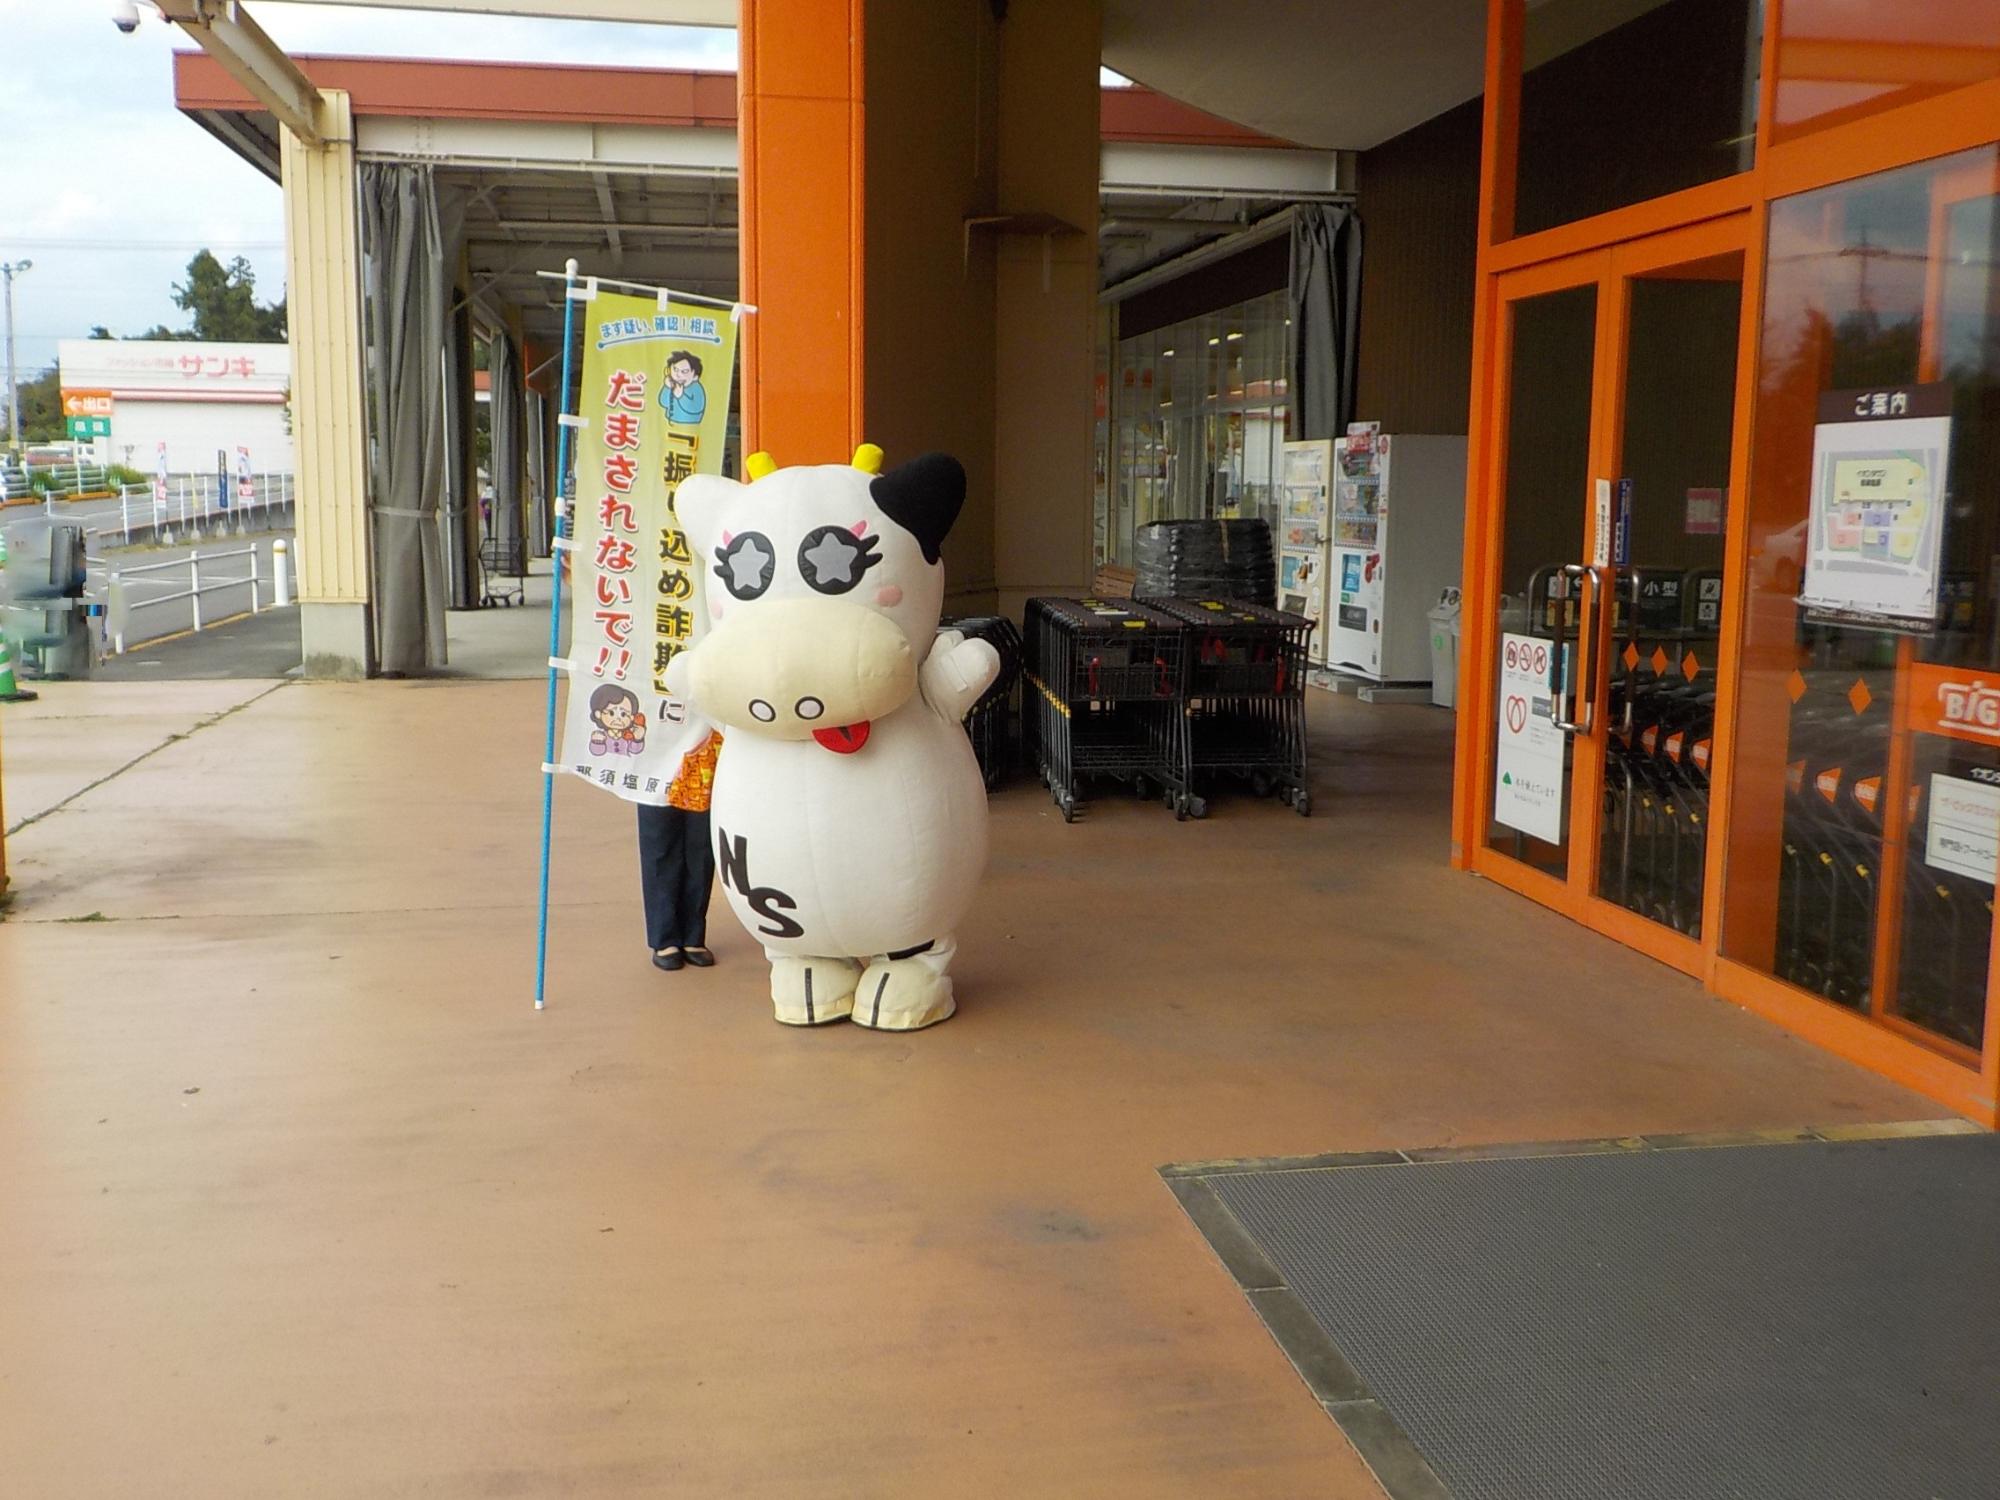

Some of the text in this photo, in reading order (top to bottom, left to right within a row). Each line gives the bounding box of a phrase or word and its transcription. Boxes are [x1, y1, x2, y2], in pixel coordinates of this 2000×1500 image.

[178, 355, 256, 378] サンキ
[82, 395, 111, 411] 出口
[1855, 392, 1907, 415] ご案内
[1644, 580, 1678, 597] 小型
